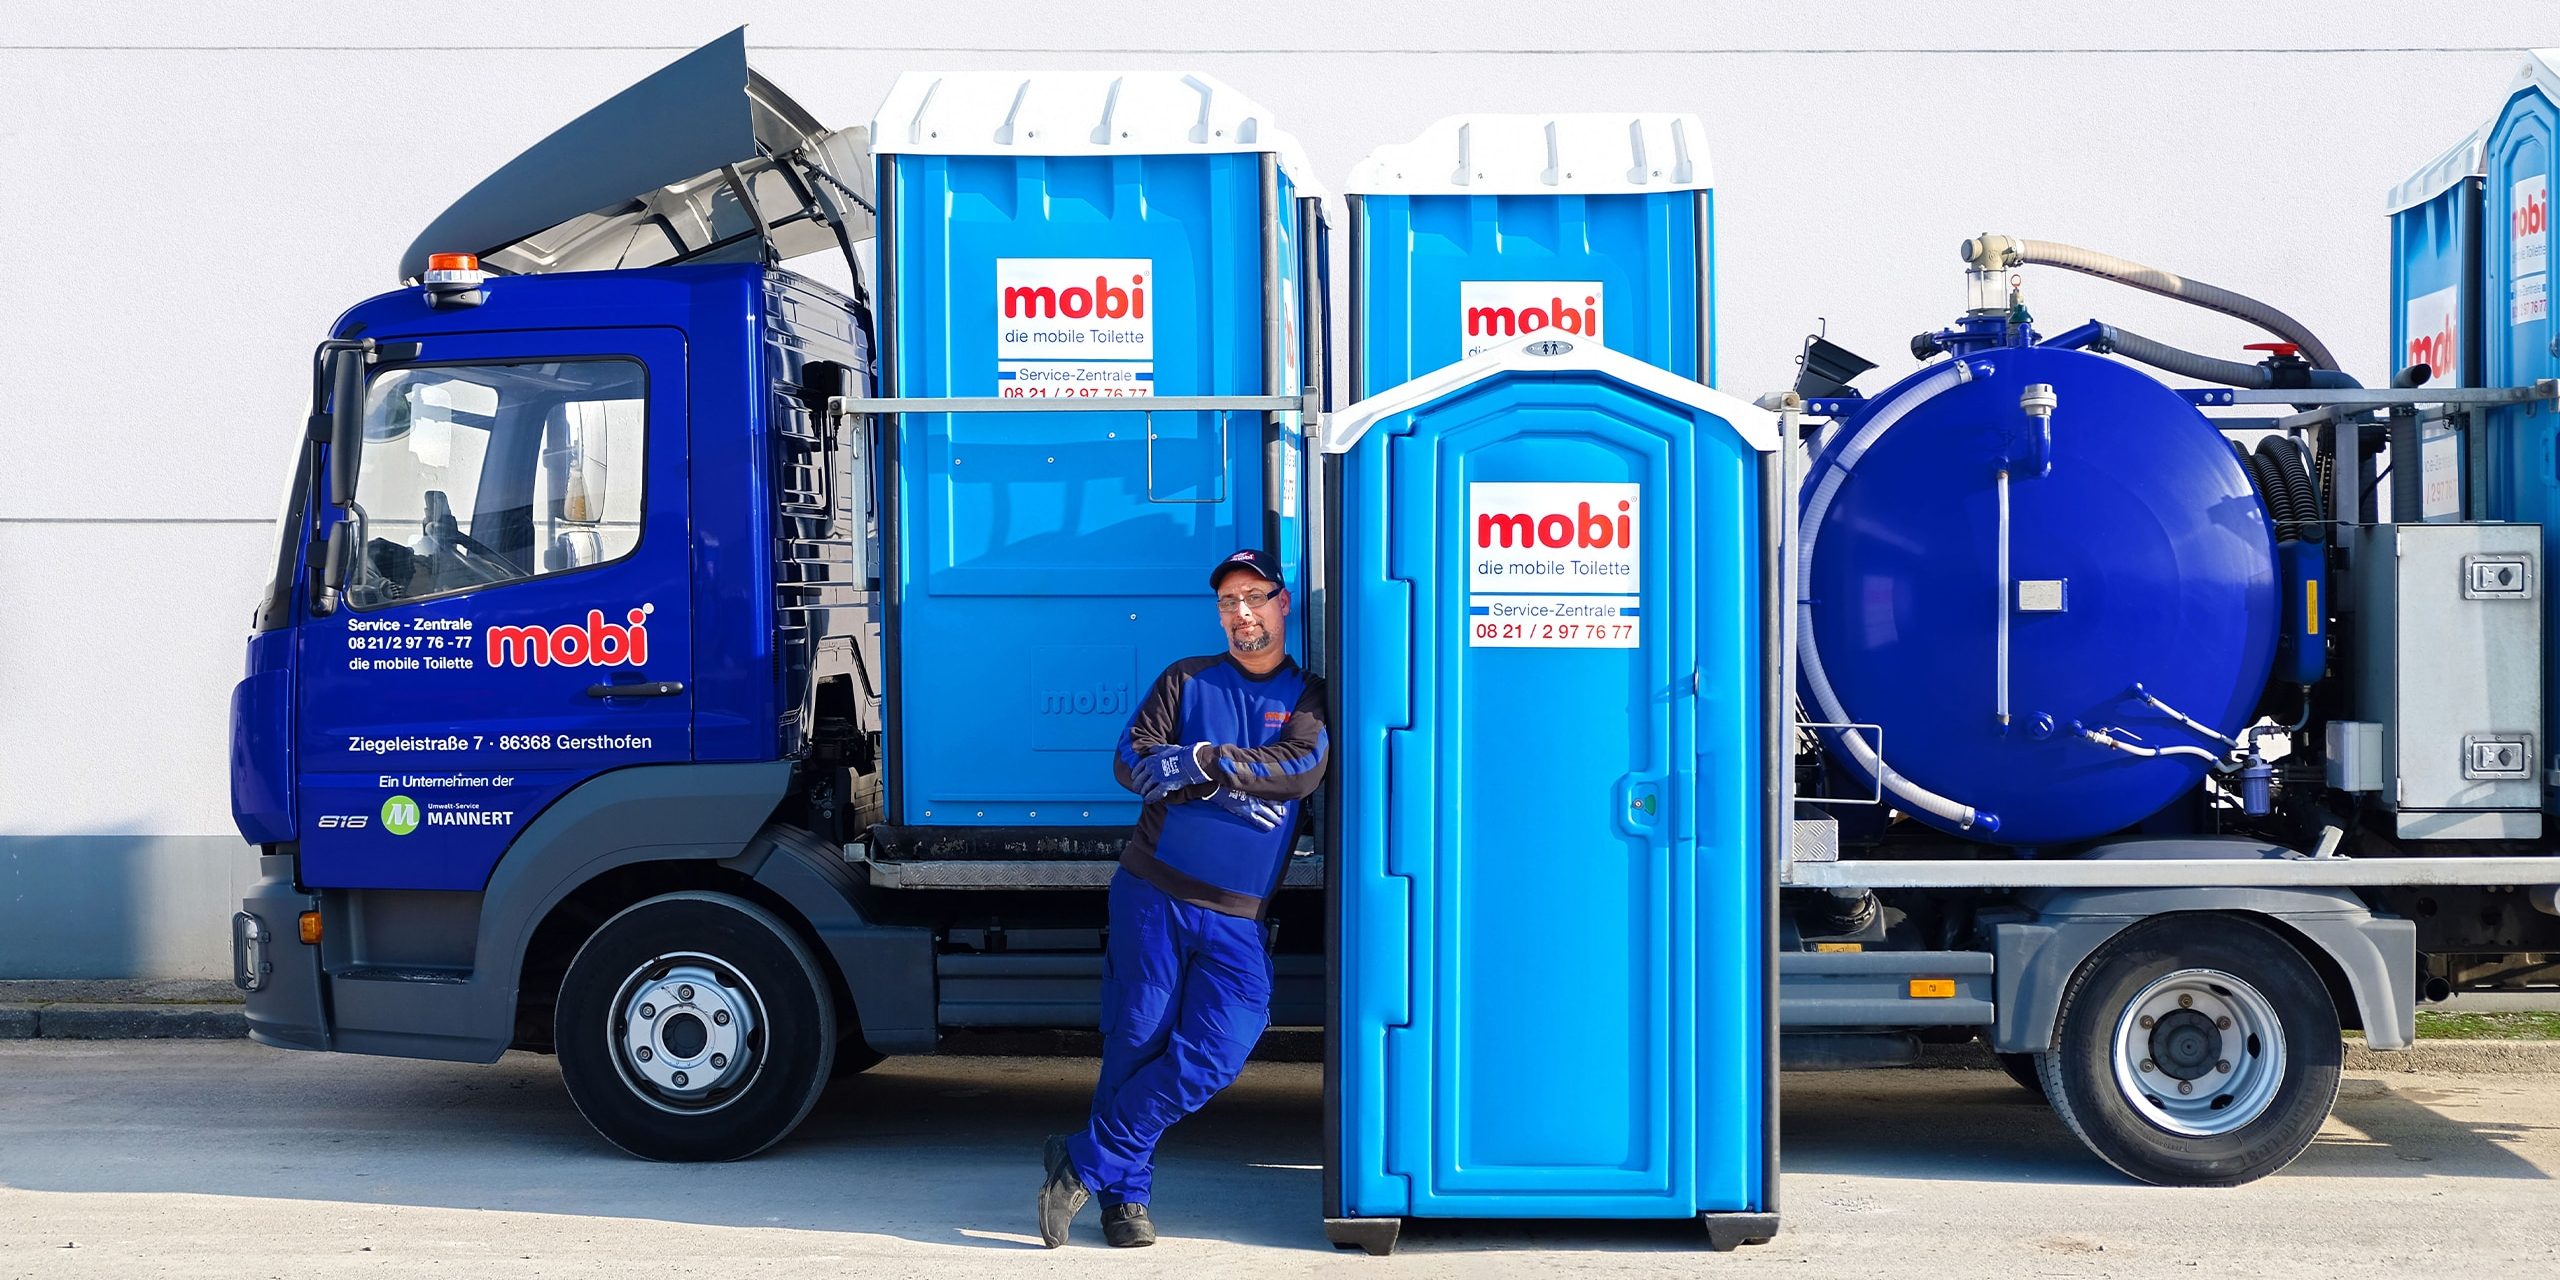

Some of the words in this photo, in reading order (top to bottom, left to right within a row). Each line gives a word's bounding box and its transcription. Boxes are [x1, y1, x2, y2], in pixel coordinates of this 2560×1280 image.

[1004, 274, 1144, 318] mobi
[1468, 296, 1595, 336] mobi
[1005, 329, 1028, 343] die
[1034, 329, 1084, 343] mobile
[1090, 329, 1144, 343] Toilette
[1020, 368, 1132, 381] Service-Zentrale
[1478, 500, 1630, 548] mobi
[1478, 560, 1503, 575] die
[1509, 560, 1564, 575] mobile
[1570, 560, 1630, 575] Toilette
[1493, 602, 1616, 617] Service-Zentrale
[348, 618, 400, 631] Service
[414, 618, 472, 630] Zentrale
[1476, 624, 1497, 638] 08
[1502, 624, 1522, 638] 21
[1530, 624, 1536, 638] /
[1542, 624, 1553, 638] 2
[1559, 624, 1579, 638] 97
[1586, 624, 1606, 638] 76
[1612, 624, 1632, 638] 77
[405, 636, 422, 649] 97
[427, 636, 444, 649] 76
[486, 608, 648, 668] mobi
[349, 658, 370, 670] die
[374, 657, 420, 670] mobile
[423, 657, 473, 669] Toilette
[1040, 682, 1128, 715] mobi
[348, 736, 468, 754] Ziegeleistraße
[473, 736, 483, 750] 7
[499, 736, 551, 750] 86368
[556, 734, 652, 750] Gersthofen
[379, 775, 399, 787] Ein
[402, 775, 489, 787] Unternehmen
[492, 775, 514, 787] der
[428, 812, 514, 826] MANNERT
